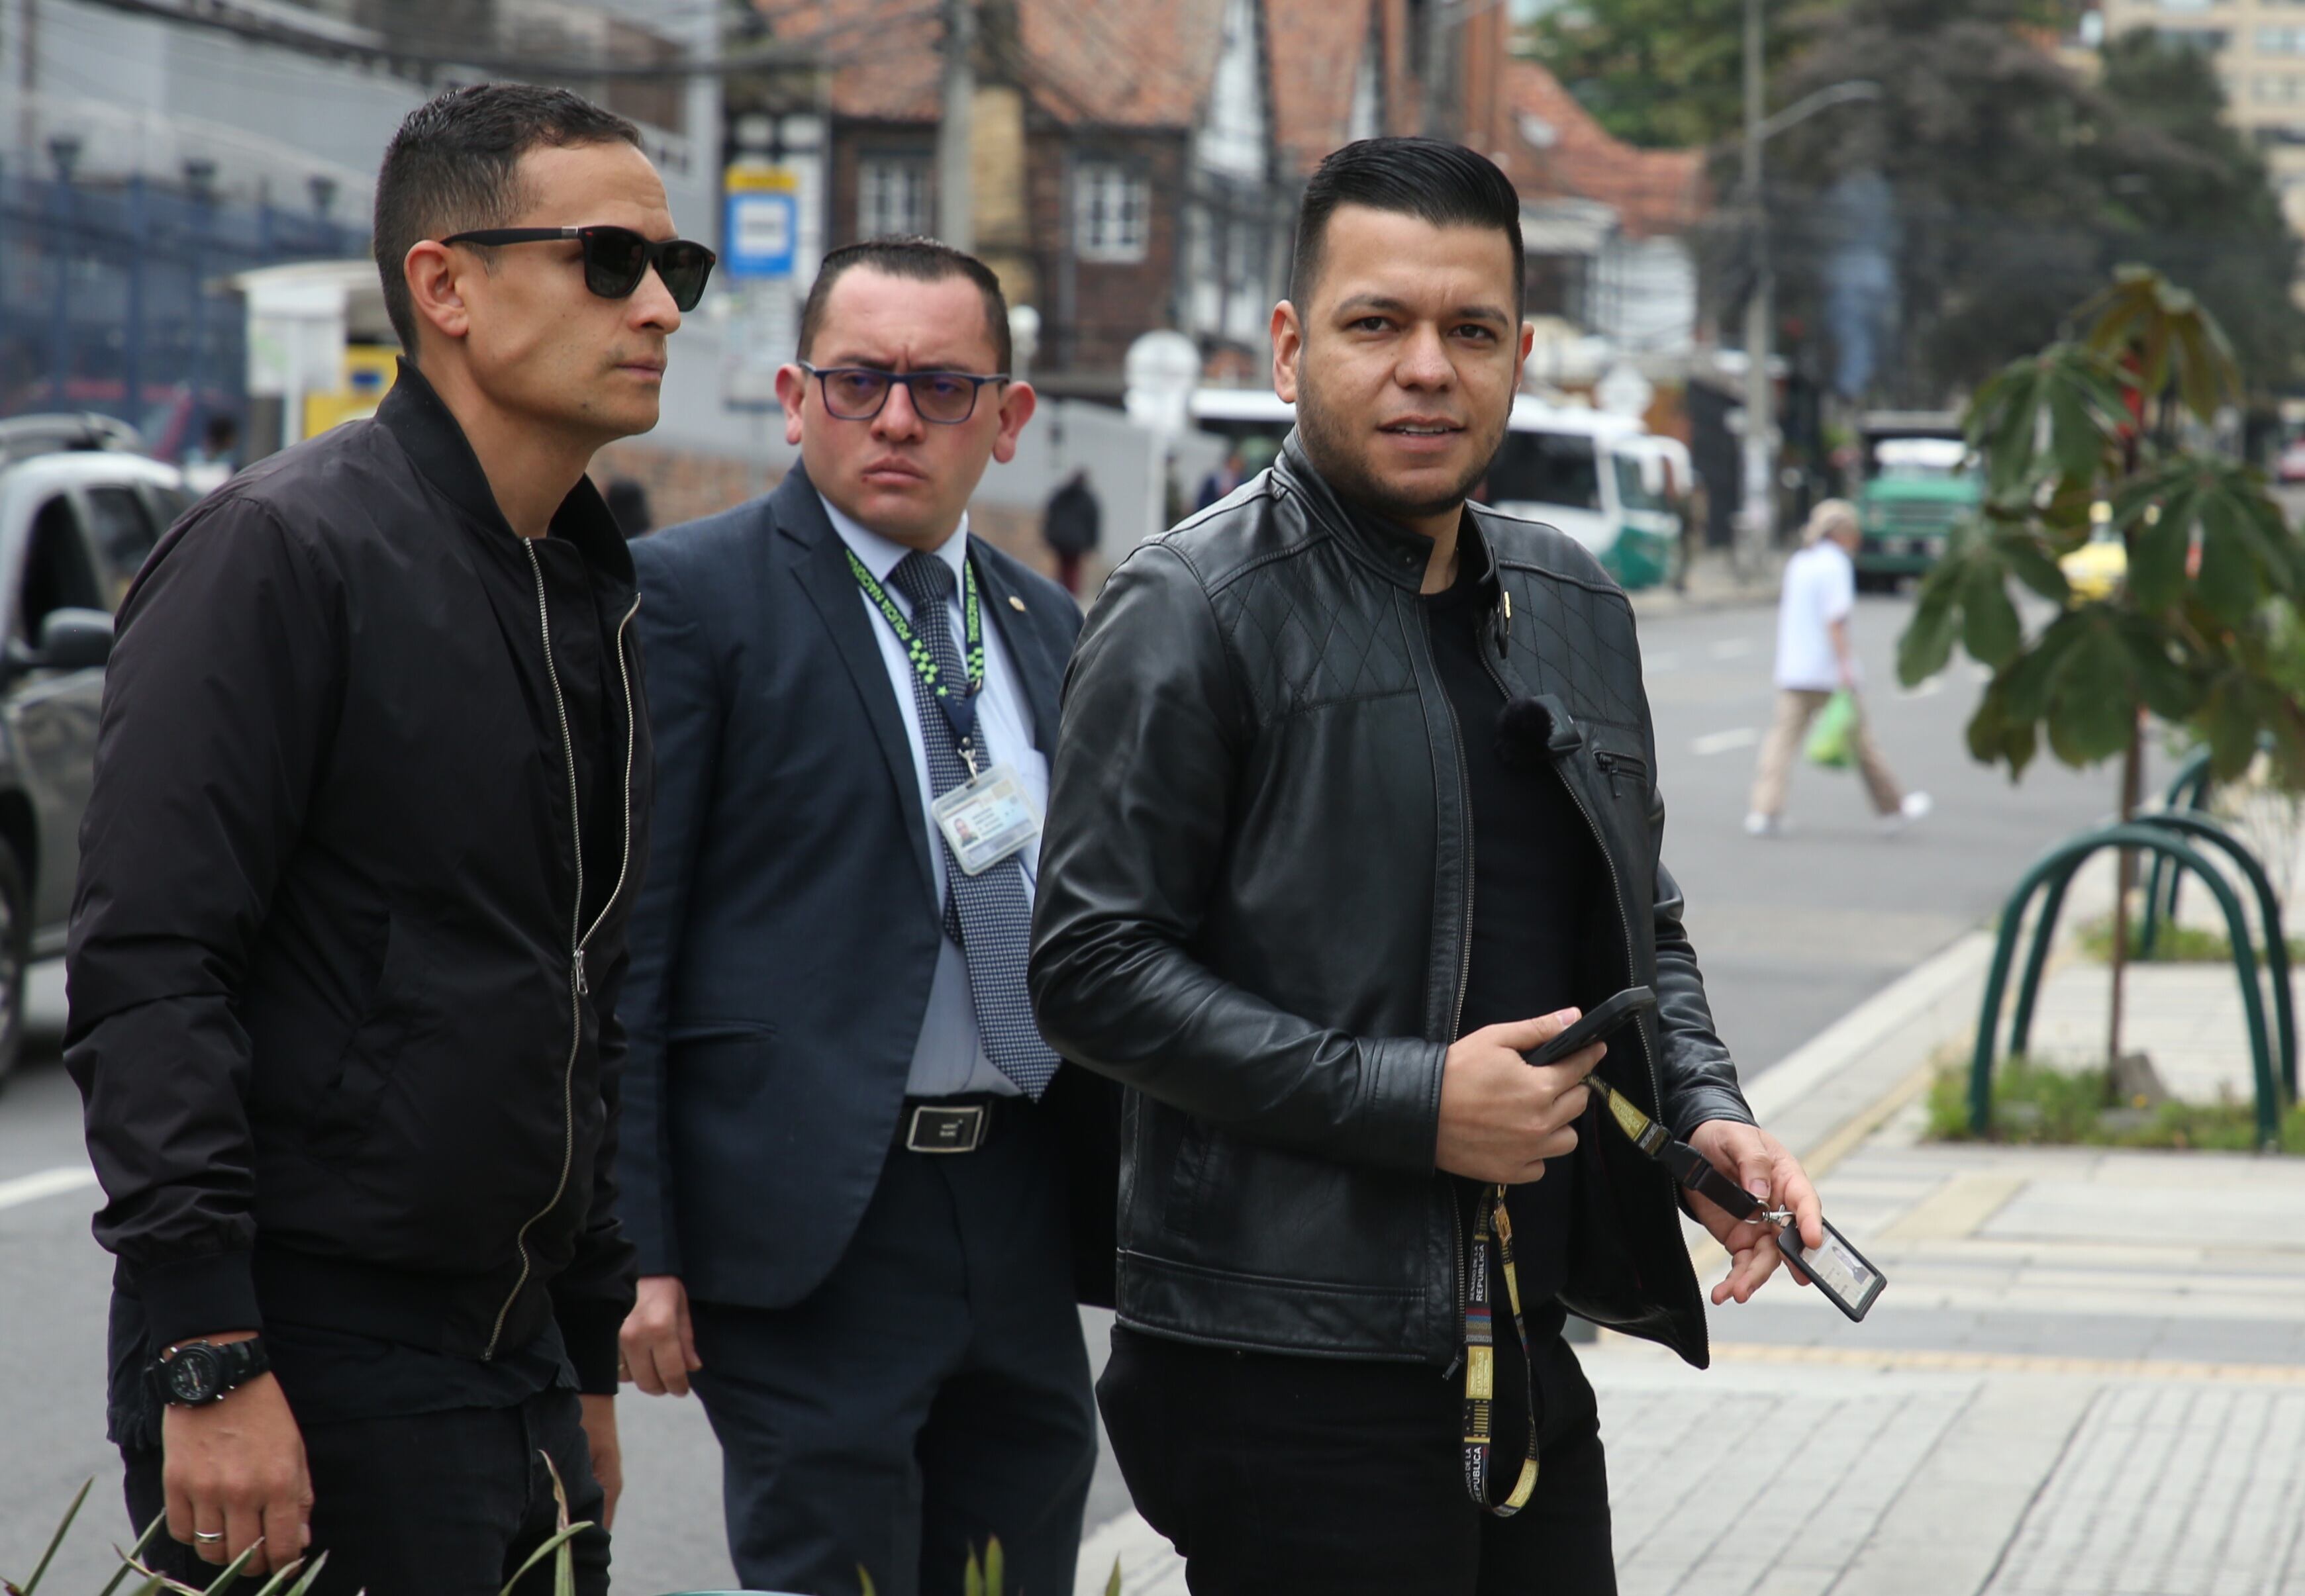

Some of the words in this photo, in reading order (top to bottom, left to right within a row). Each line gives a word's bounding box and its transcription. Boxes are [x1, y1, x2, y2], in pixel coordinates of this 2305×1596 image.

[846, 549, 885, 602] NACION
[1465, 1447, 1471, 1459] LA
[1465, 1460, 1471, 1472] DE
